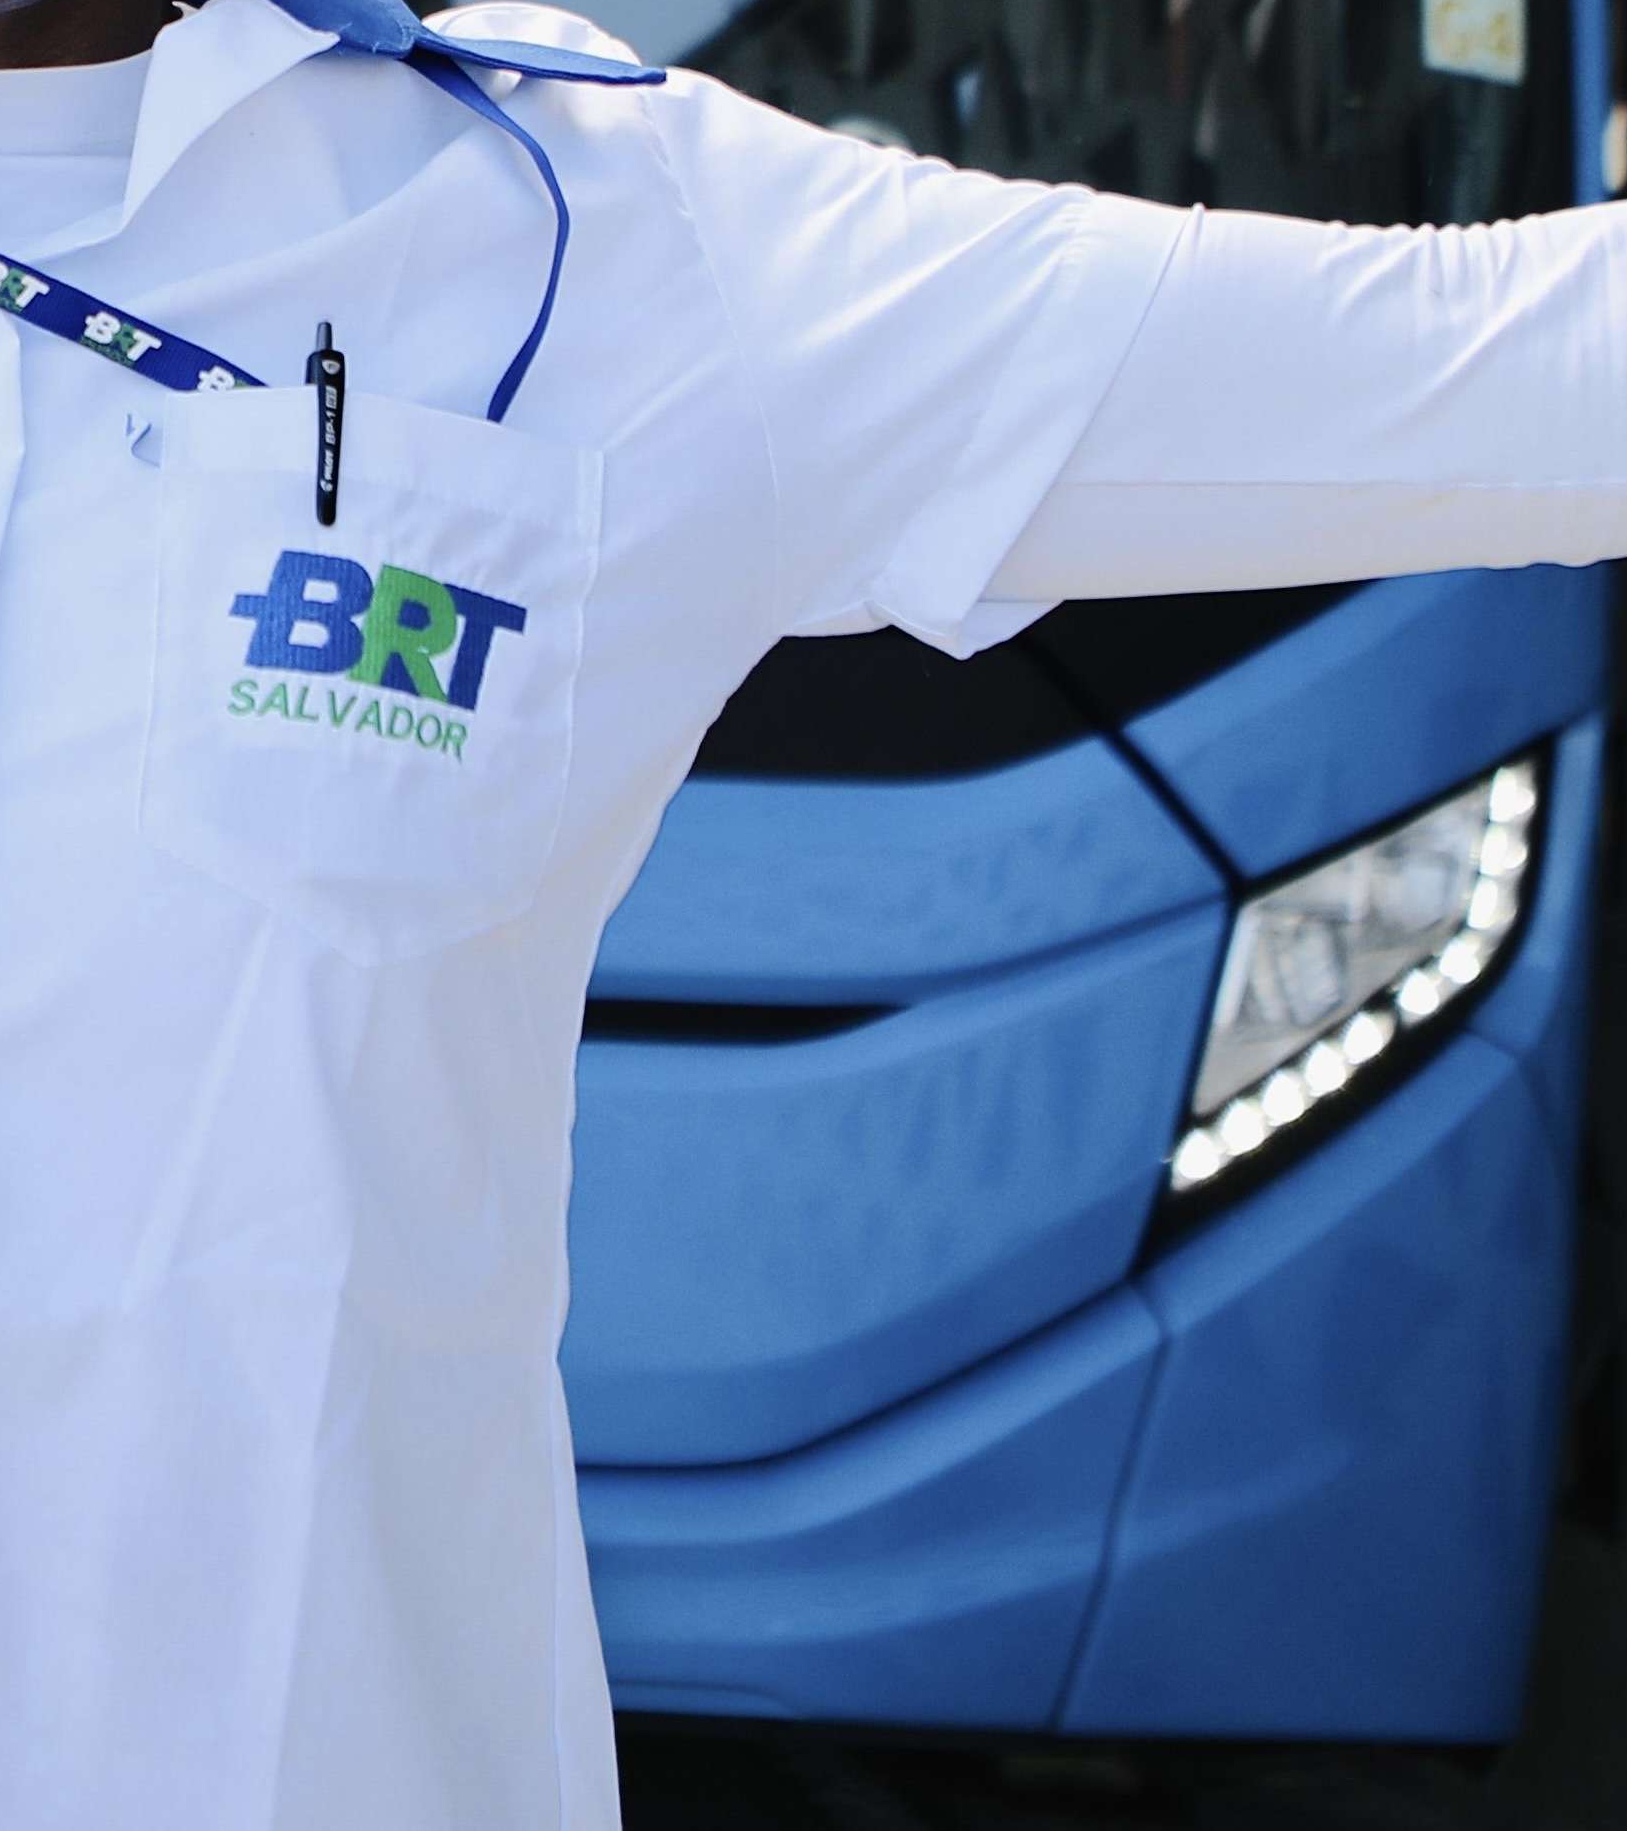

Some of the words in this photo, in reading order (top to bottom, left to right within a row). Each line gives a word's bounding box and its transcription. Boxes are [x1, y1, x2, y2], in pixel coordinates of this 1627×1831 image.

[84, 311, 162, 362] BRT
[228, 550, 528, 713] BRT
[227, 678, 469, 764] SALVADOR
